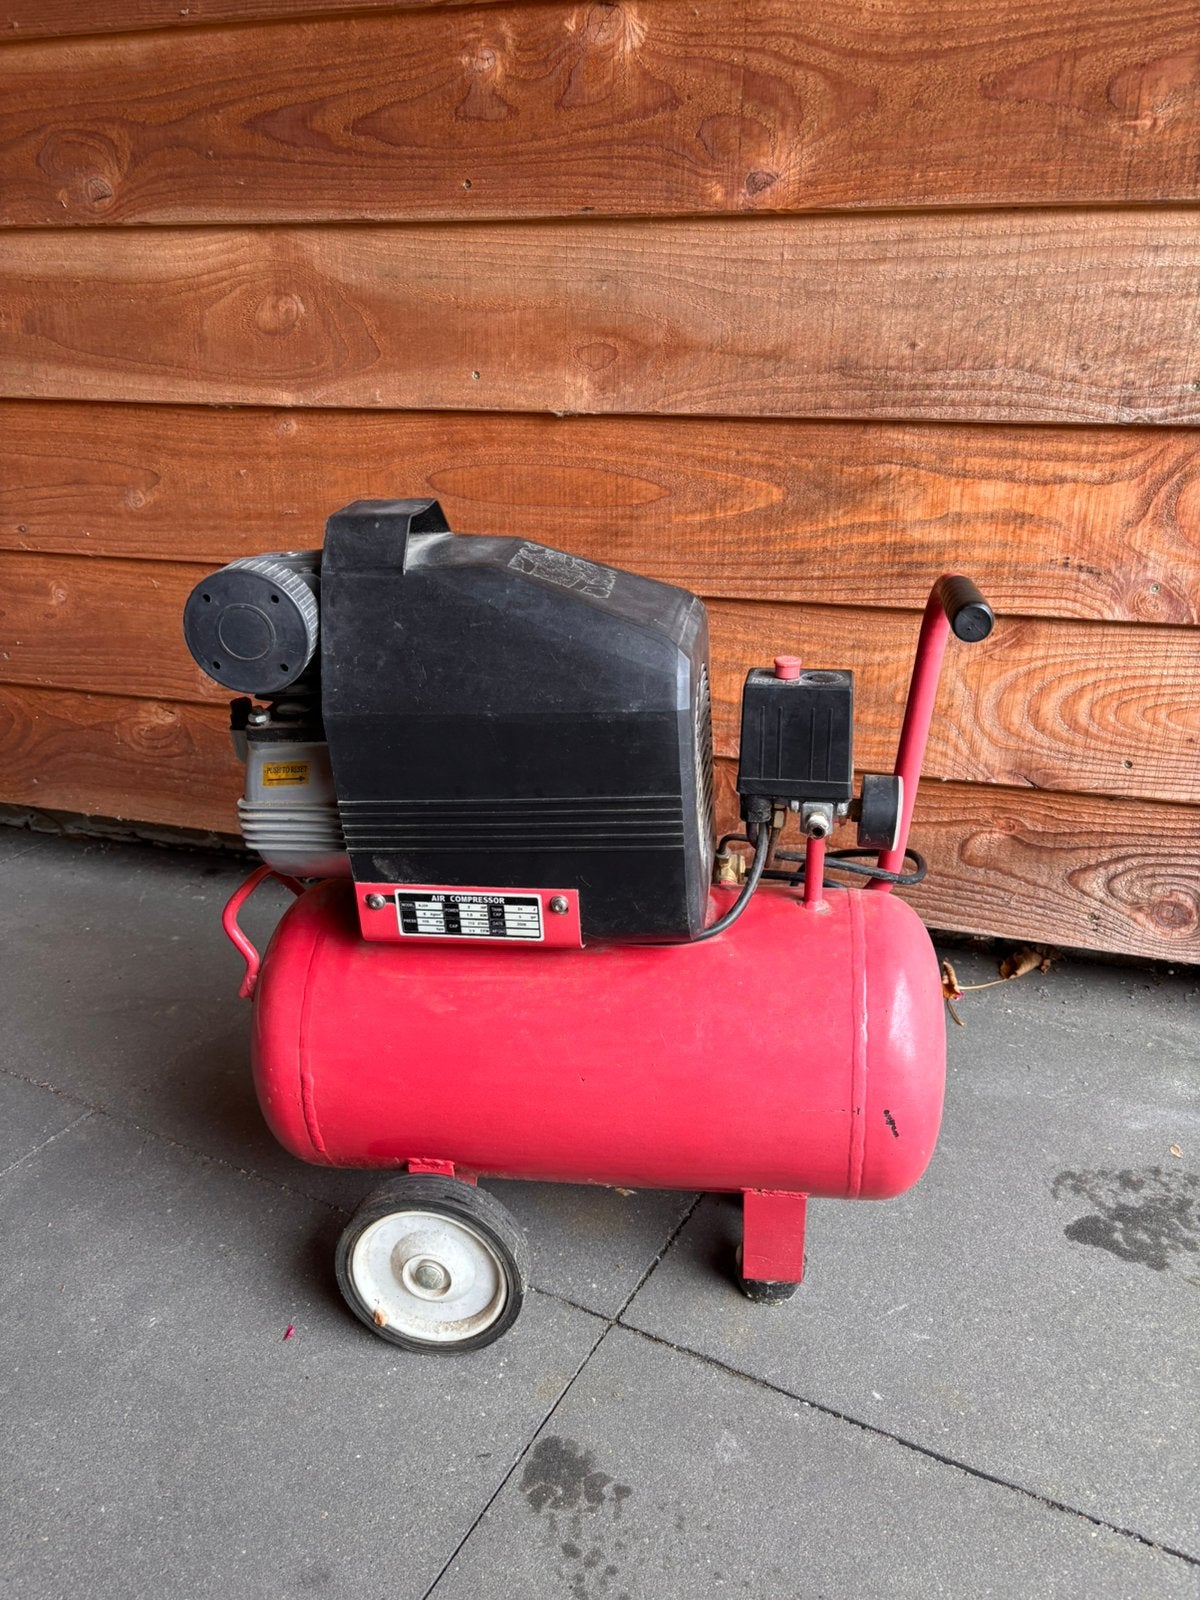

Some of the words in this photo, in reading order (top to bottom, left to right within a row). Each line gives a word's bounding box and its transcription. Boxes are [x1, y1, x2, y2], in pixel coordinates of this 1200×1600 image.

[282, 766, 290, 774] TO
[291, 765, 307, 773] RESET
[431, 894, 446, 902] AIR
[449, 895, 505, 904] COMPRESSOR
